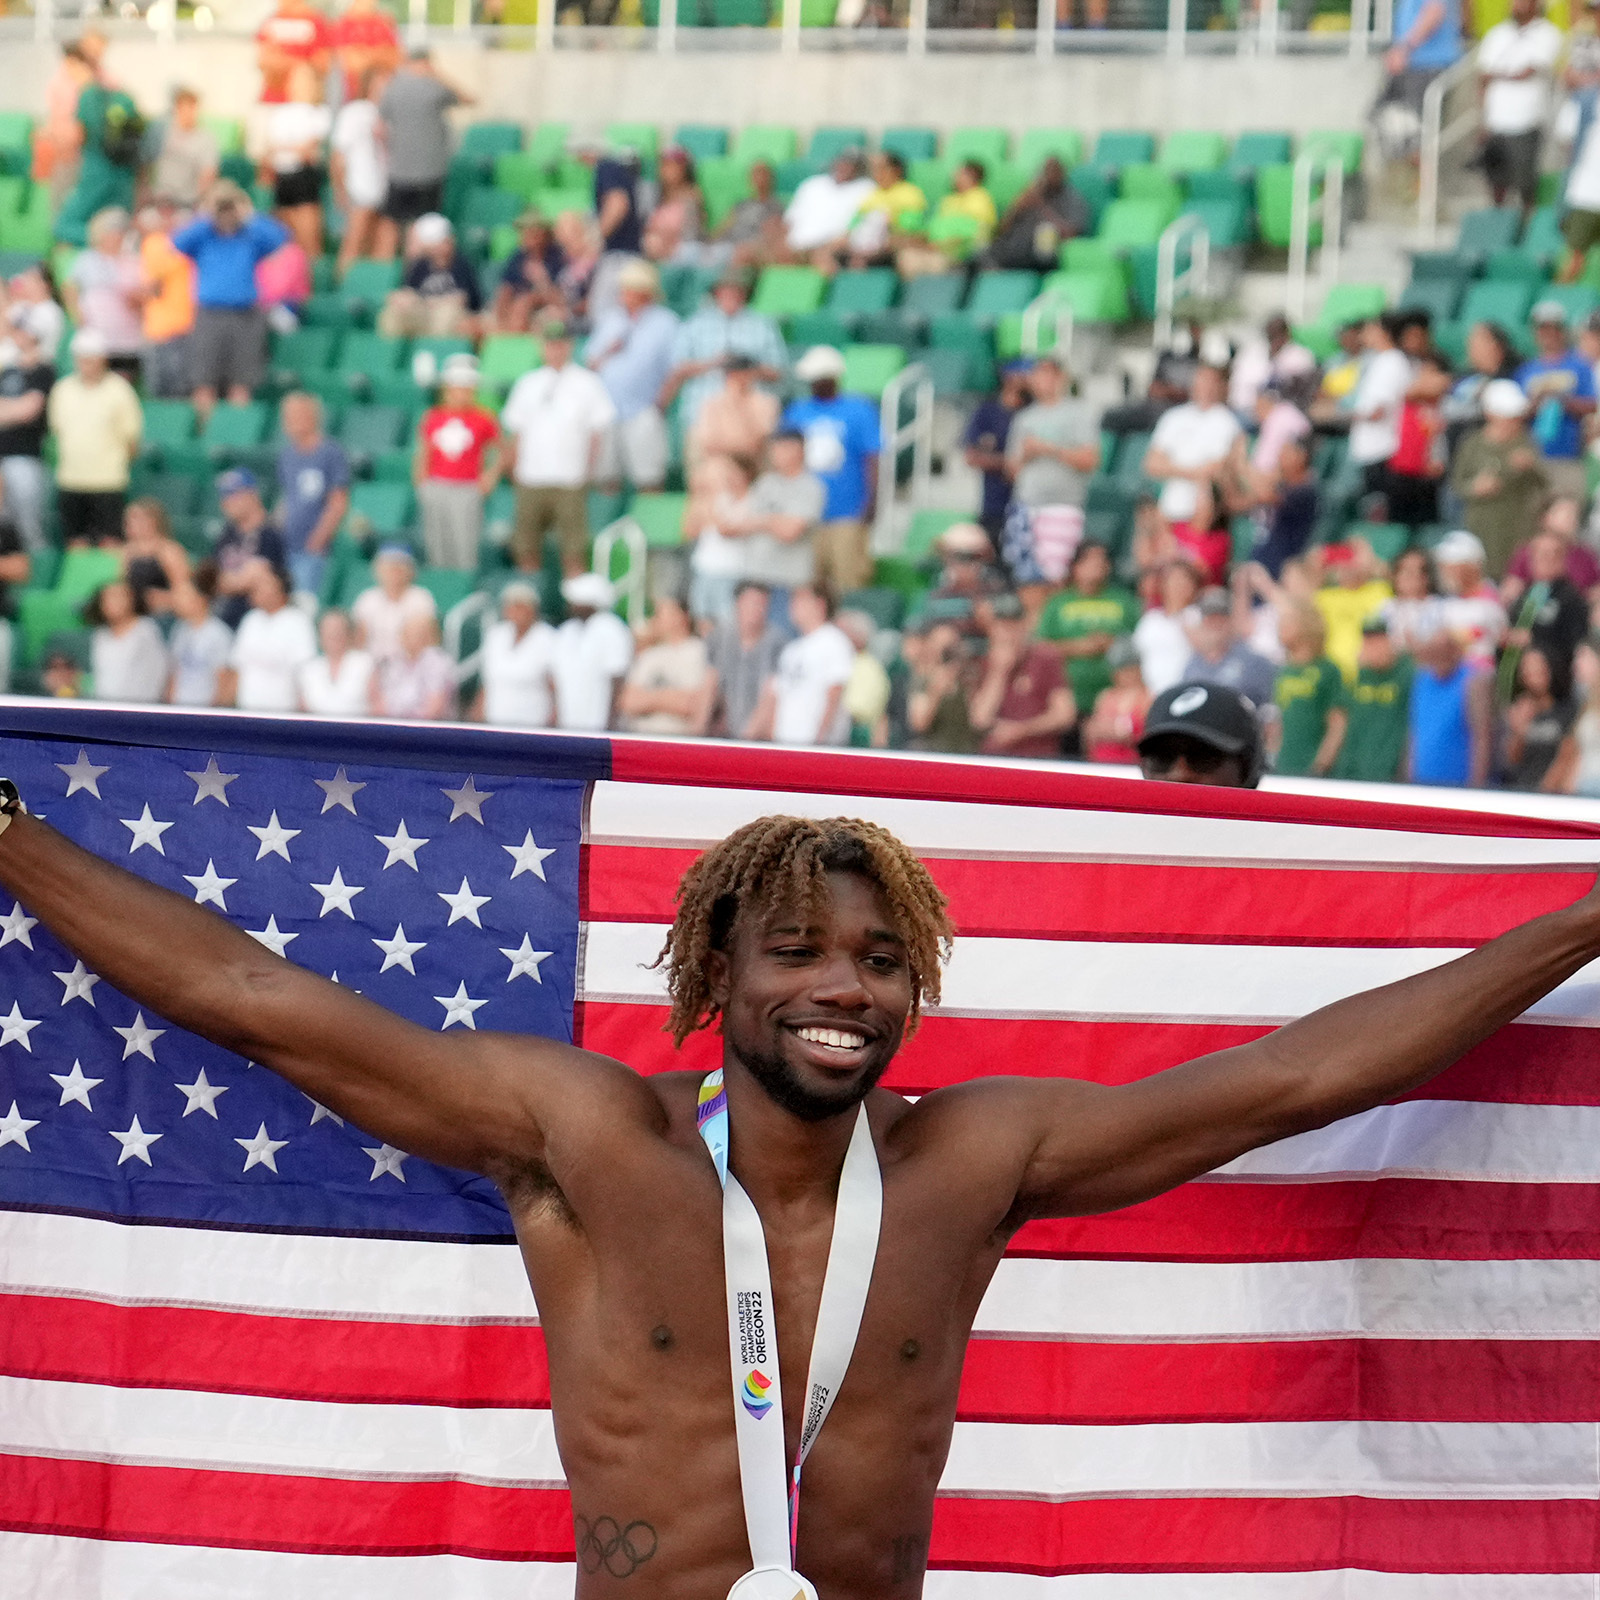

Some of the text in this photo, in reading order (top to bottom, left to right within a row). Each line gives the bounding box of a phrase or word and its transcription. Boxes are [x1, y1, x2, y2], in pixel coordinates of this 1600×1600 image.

[737, 1292, 749, 1364] WORLD ATHLETICS
[744, 1292, 756, 1364] CHAMPIONSHIPS
